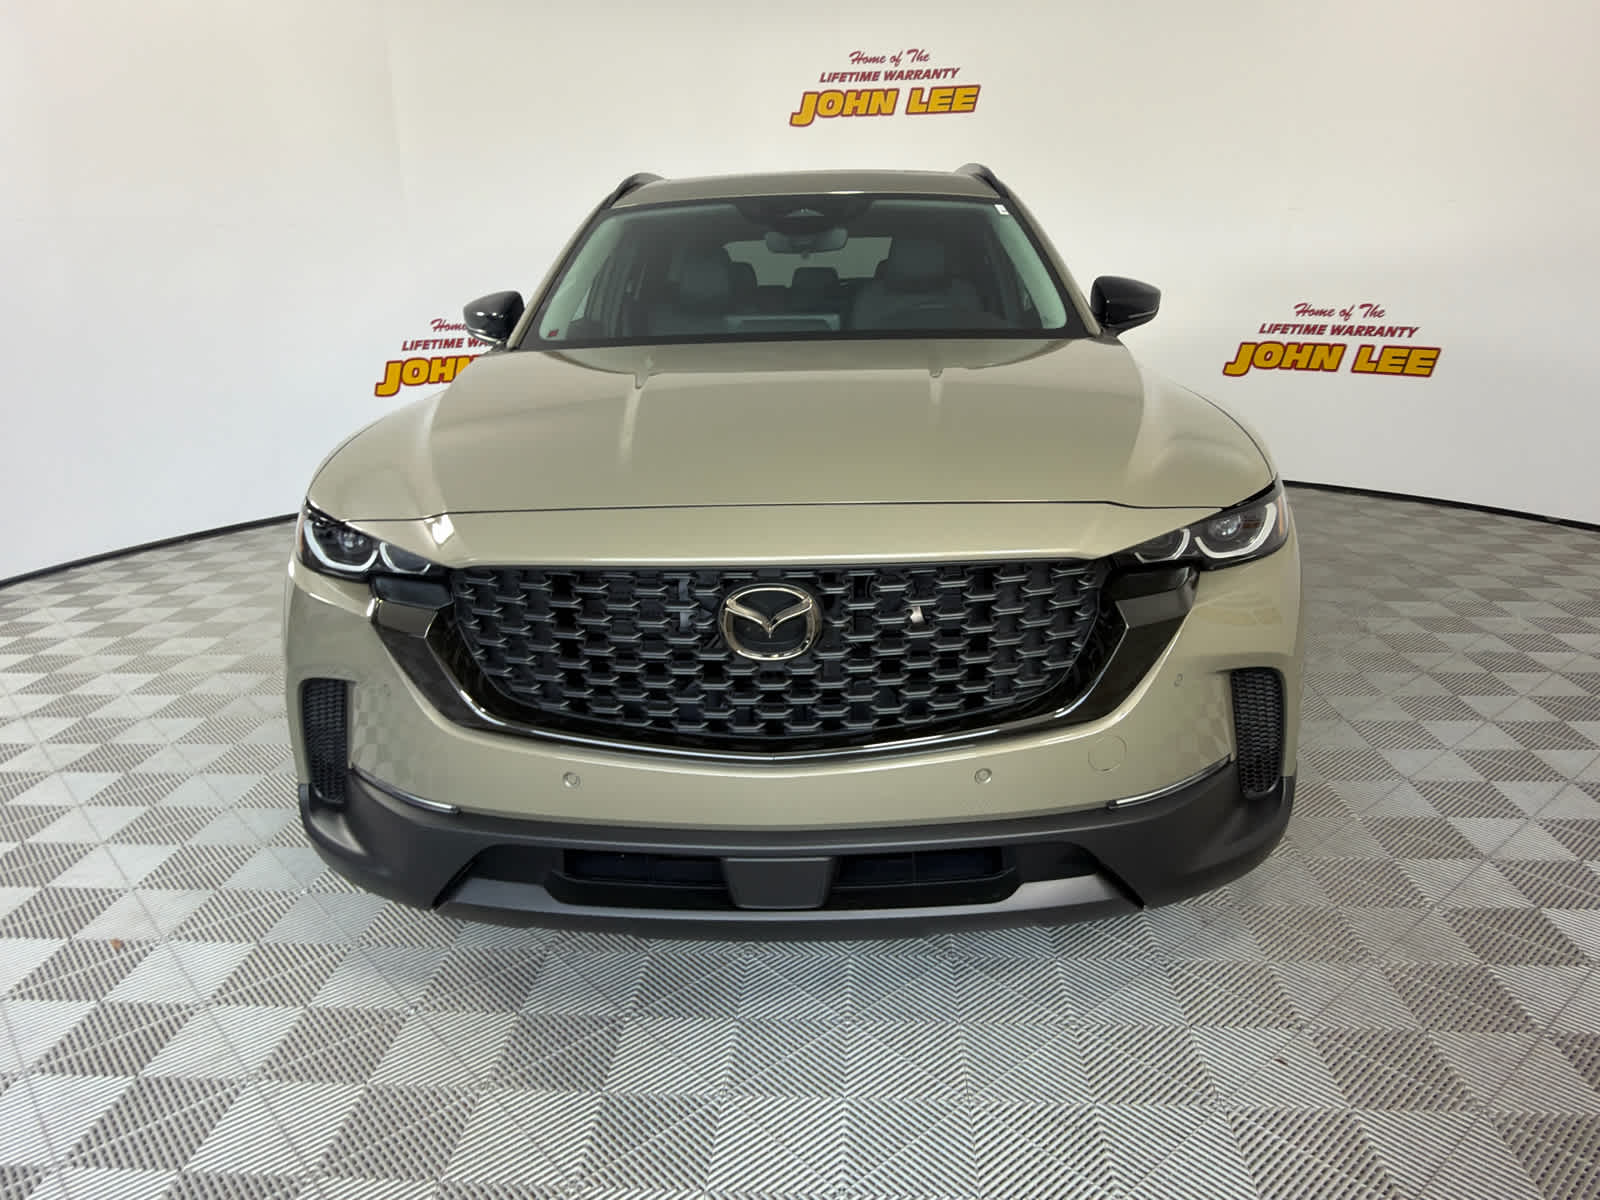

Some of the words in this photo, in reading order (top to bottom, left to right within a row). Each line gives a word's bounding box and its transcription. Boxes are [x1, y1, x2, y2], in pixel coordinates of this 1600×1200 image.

[849, 50, 886, 65] Home
[890, 50, 904, 67] of
[906, 48, 930, 63] The
[819, 71, 881, 83] LIFETIME
[884, 67, 961, 81] WARRANTY
[789, 88, 900, 127] JOHN
[905, 84, 981, 115] LEE
[1294, 302, 1335, 318] Home
[1339, 304, 1355, 322] of
[1358, 303, 1385, 319] The
[1258, 323, 1328, 336] LIFETIME
[1330, 324, 1421, 339] WARRANTY
[401, 337, 465, 351] LIFETIME
[1222, 341, 1347, 377] JOHN
[1350, 344, 1442, 378] LEE
